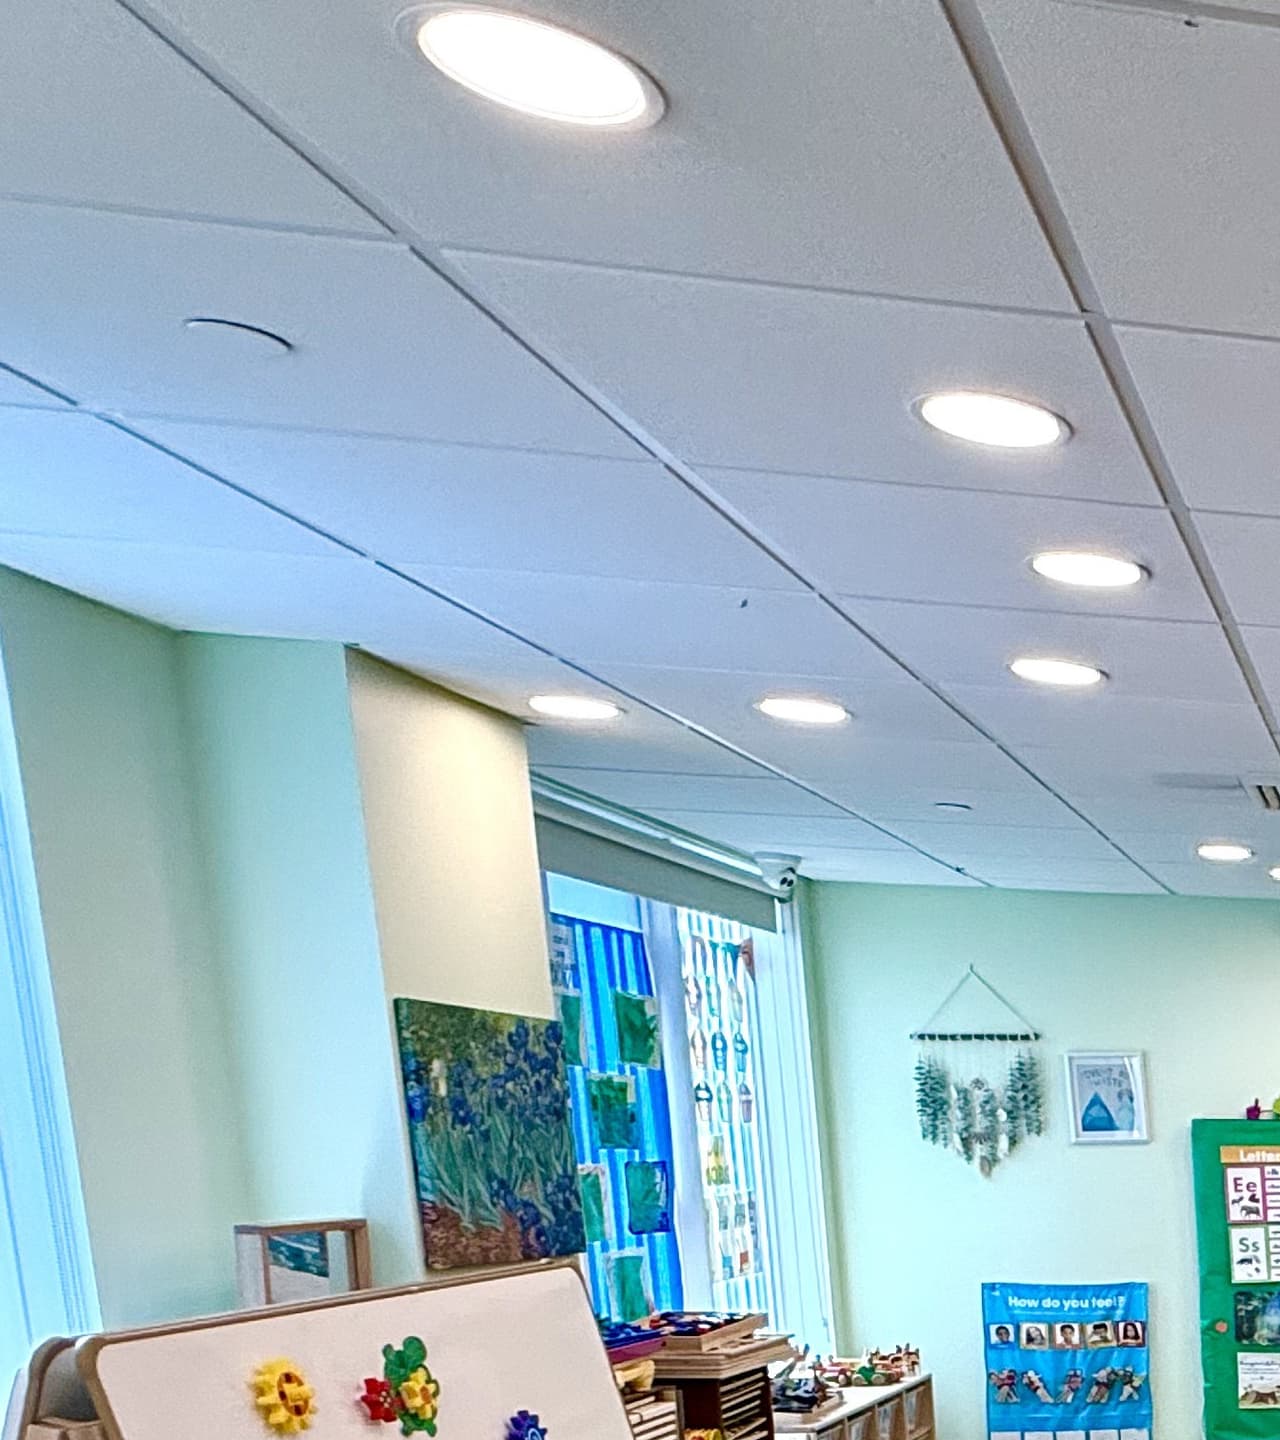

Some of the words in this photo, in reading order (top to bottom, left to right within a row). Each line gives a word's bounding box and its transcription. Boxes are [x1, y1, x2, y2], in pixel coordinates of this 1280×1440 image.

[1233, 1177, 1257, 1193] Ee
[1238, 1237, 1260, 1253] Ss
[1008, 1296, 1038, 1308] How
[1041, 1296, 1061, 1308] do
[1062, 1298, 1089, 1311] you
